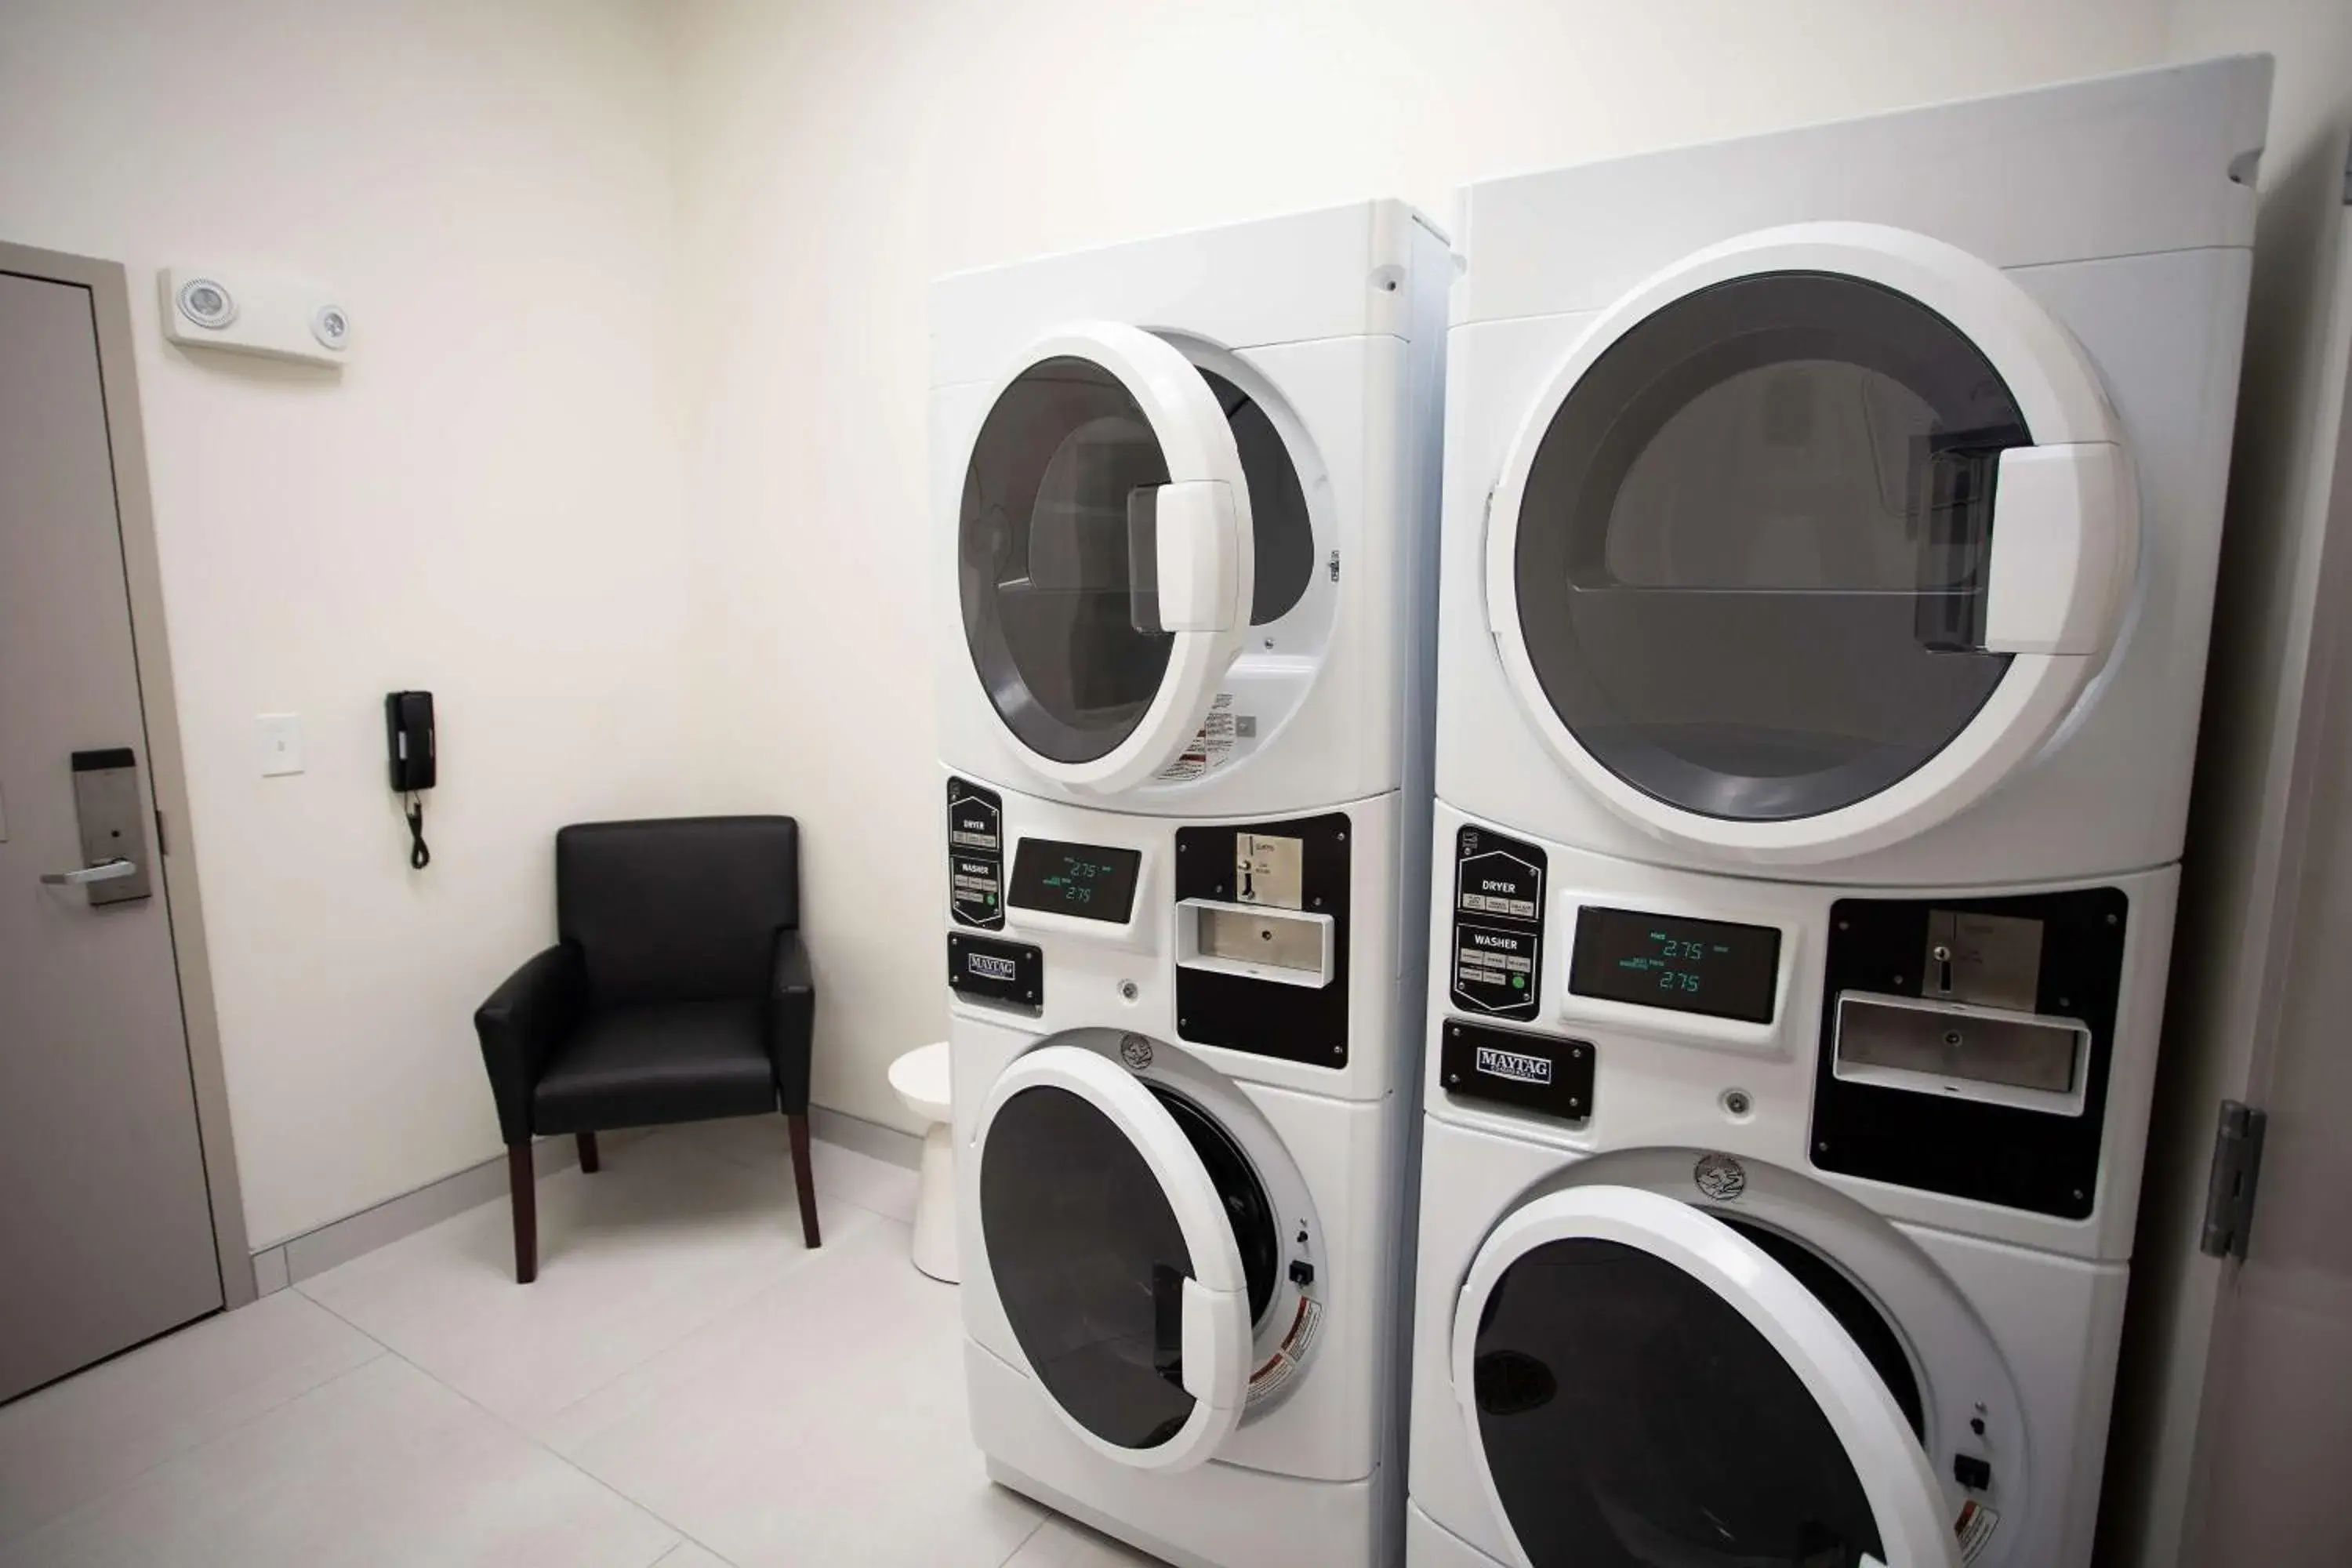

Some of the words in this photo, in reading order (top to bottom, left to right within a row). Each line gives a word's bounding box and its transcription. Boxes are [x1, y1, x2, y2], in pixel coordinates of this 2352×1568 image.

[1483, 880, 1515, 893] DRYER
[1475, 934, 1517, 949] WASHER
[971, 955, 1012, 973] MAYTAG
[1481, 1051, 1547, 1075] MAYTAG
